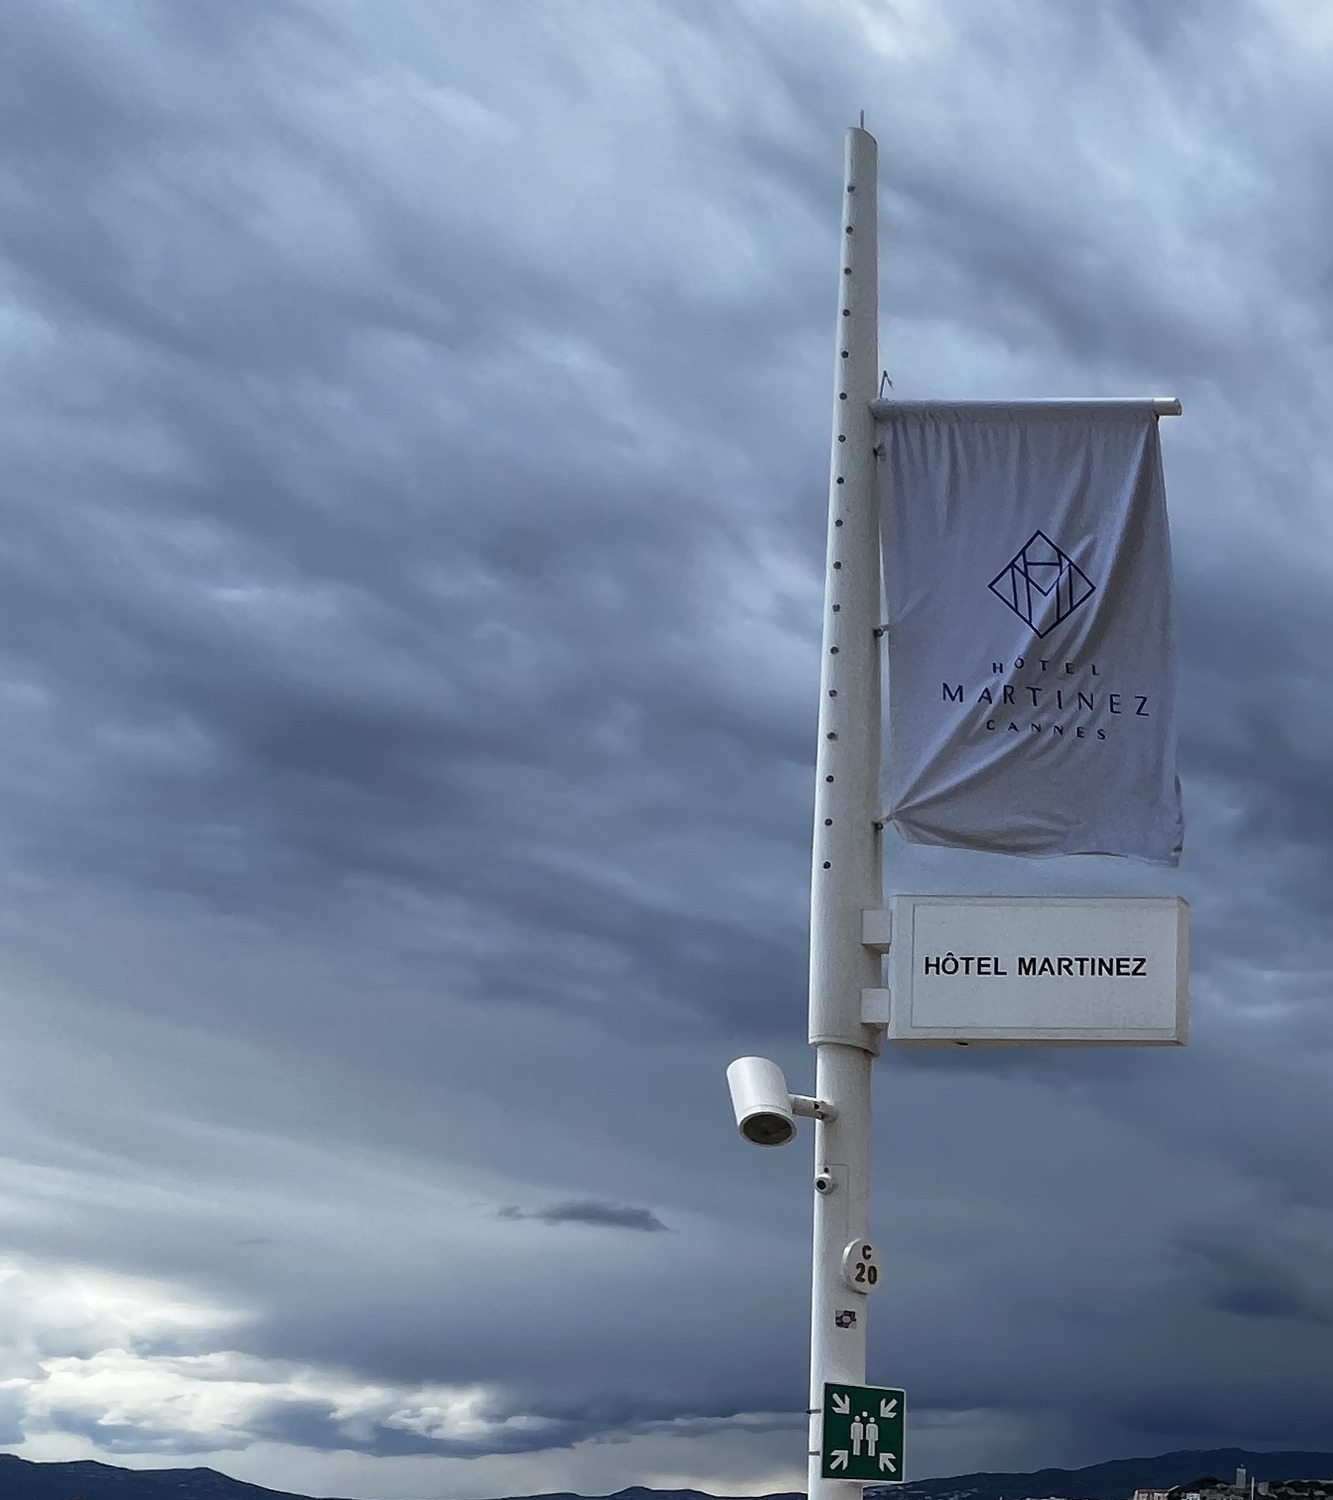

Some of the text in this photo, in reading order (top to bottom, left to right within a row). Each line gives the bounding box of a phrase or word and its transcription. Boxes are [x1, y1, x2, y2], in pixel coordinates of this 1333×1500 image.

[941, 682, 1151, 717] MARTINEZ
[985, 718, 1107, 741] CANNES
[924, 951, 1148, 977] HÔTEL MARTINEZ
[861, 1244, 873, 1260] C
[854, 1261, 878, 1286] 20
